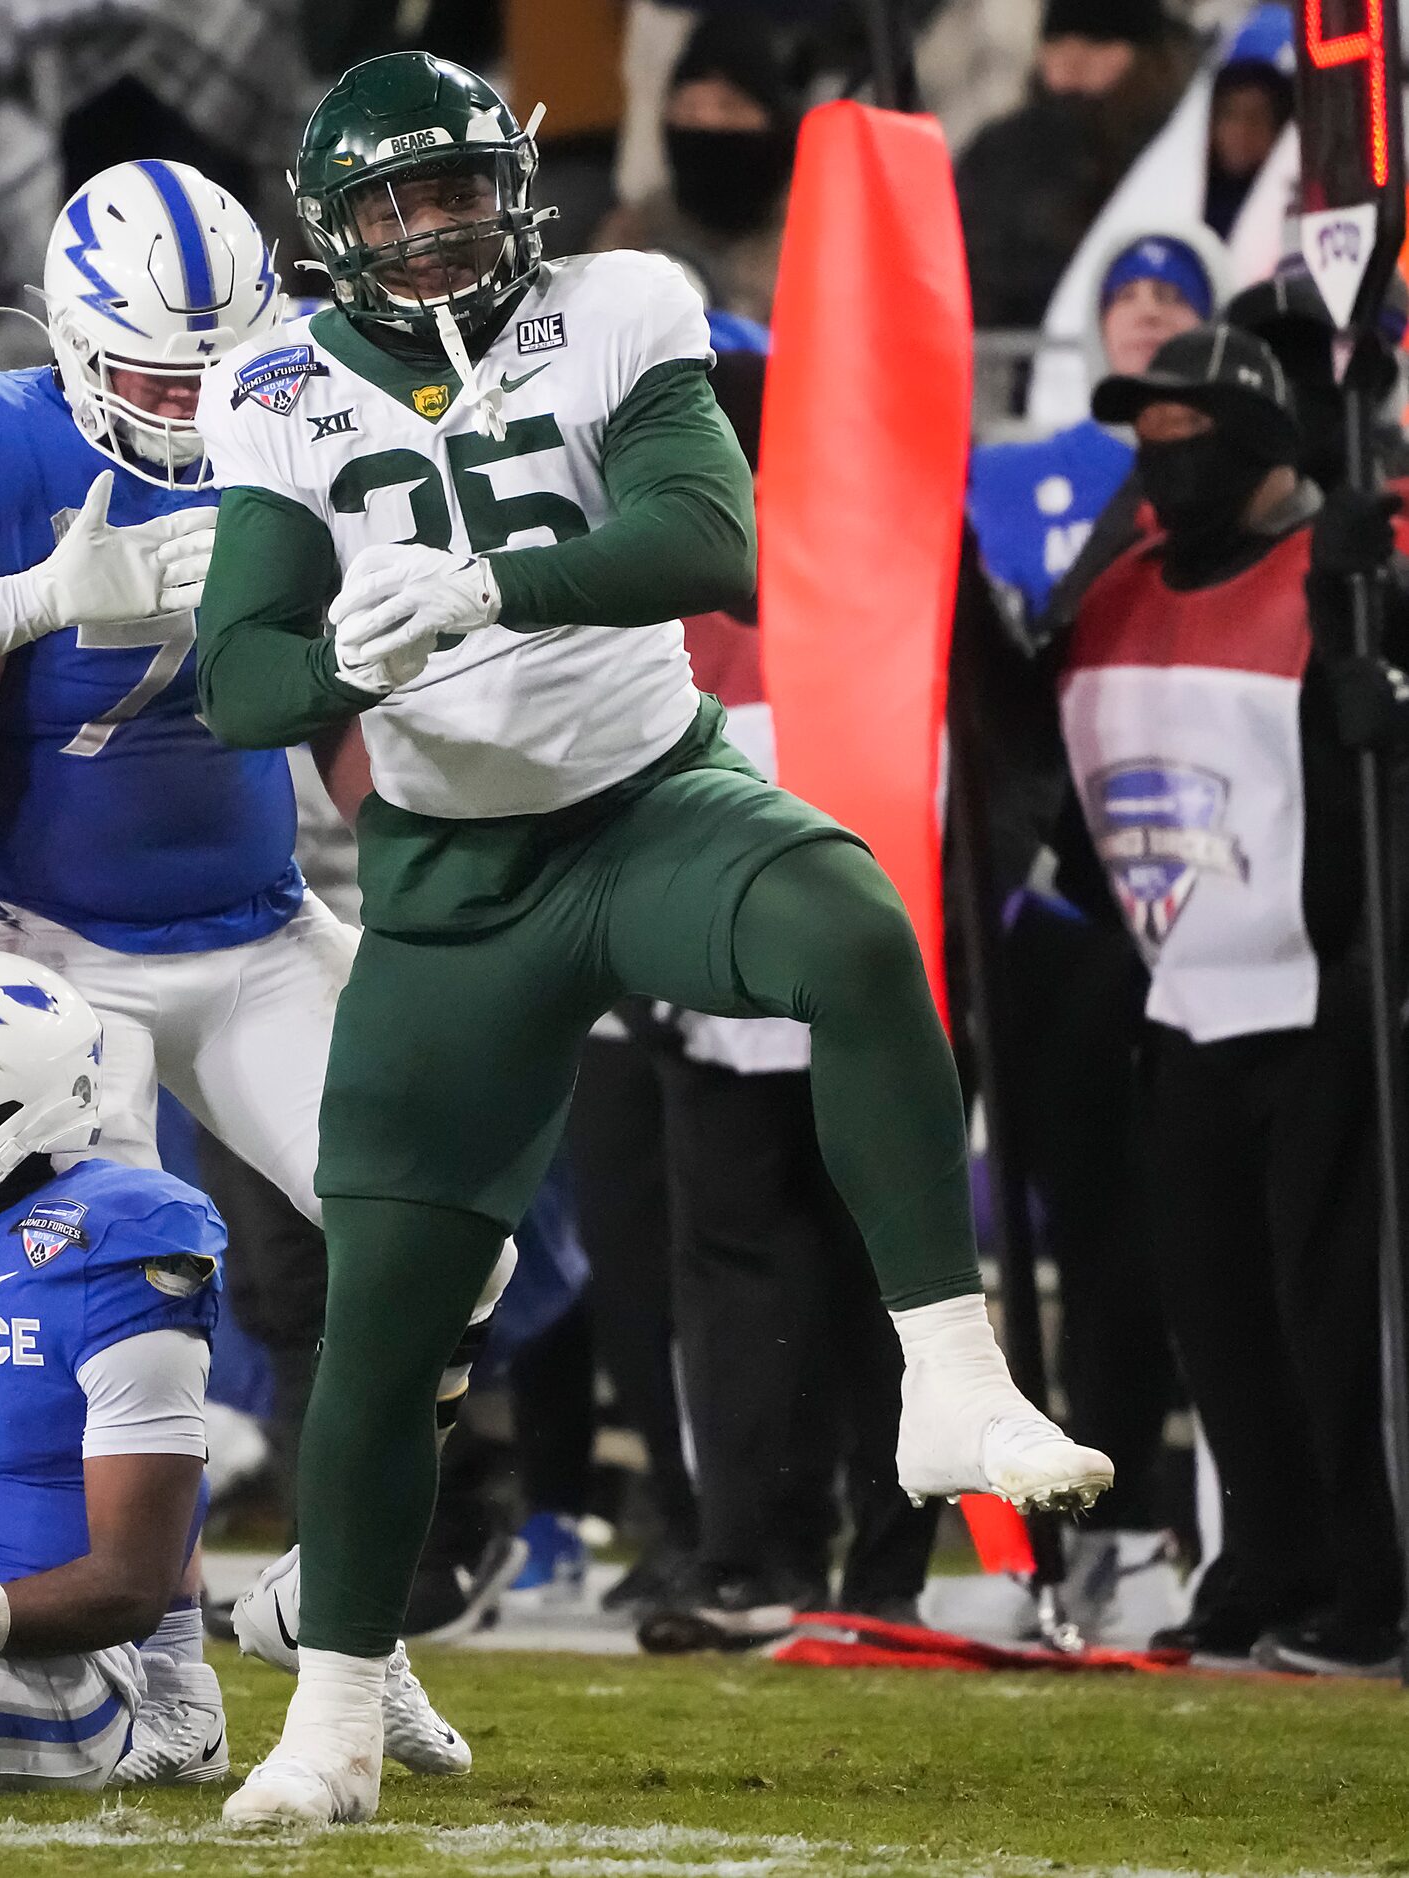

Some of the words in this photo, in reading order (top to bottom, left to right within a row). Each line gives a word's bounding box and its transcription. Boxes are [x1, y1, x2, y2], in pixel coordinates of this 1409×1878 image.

[391, 131, 436, 154] BEARS
[519, 315, 562, 345] ONE
[238, 371, 272, 396] ARMED
[274, 363, 318, 378] FORCES
[262, 377, 294, 393] BOWL
[307, 407, 358, 442] XII
[59, 607, 202, 757] 7
[18, 1218, 48, 1228] ARMED
[47, 1220, 81, 1240] FORCES
